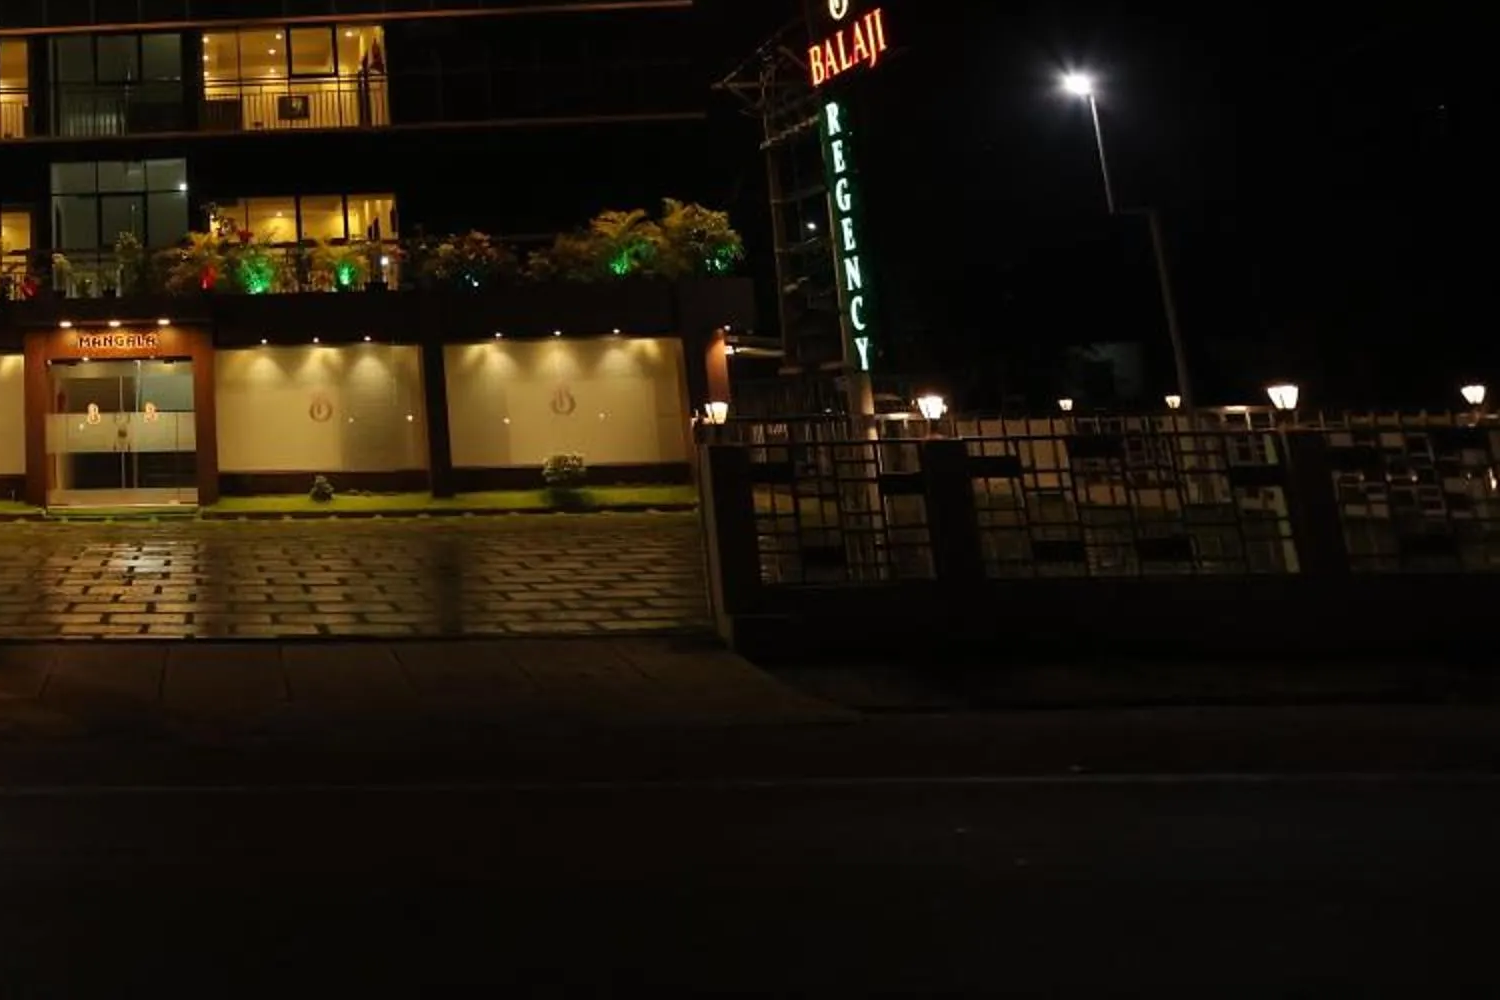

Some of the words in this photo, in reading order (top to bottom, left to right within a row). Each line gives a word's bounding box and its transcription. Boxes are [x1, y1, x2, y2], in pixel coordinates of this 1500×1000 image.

[808, 7, 887, 86] BALAJI
[825, 102, 871, 371] REGENCY
[79, 334, 157, 348] MANGALA
